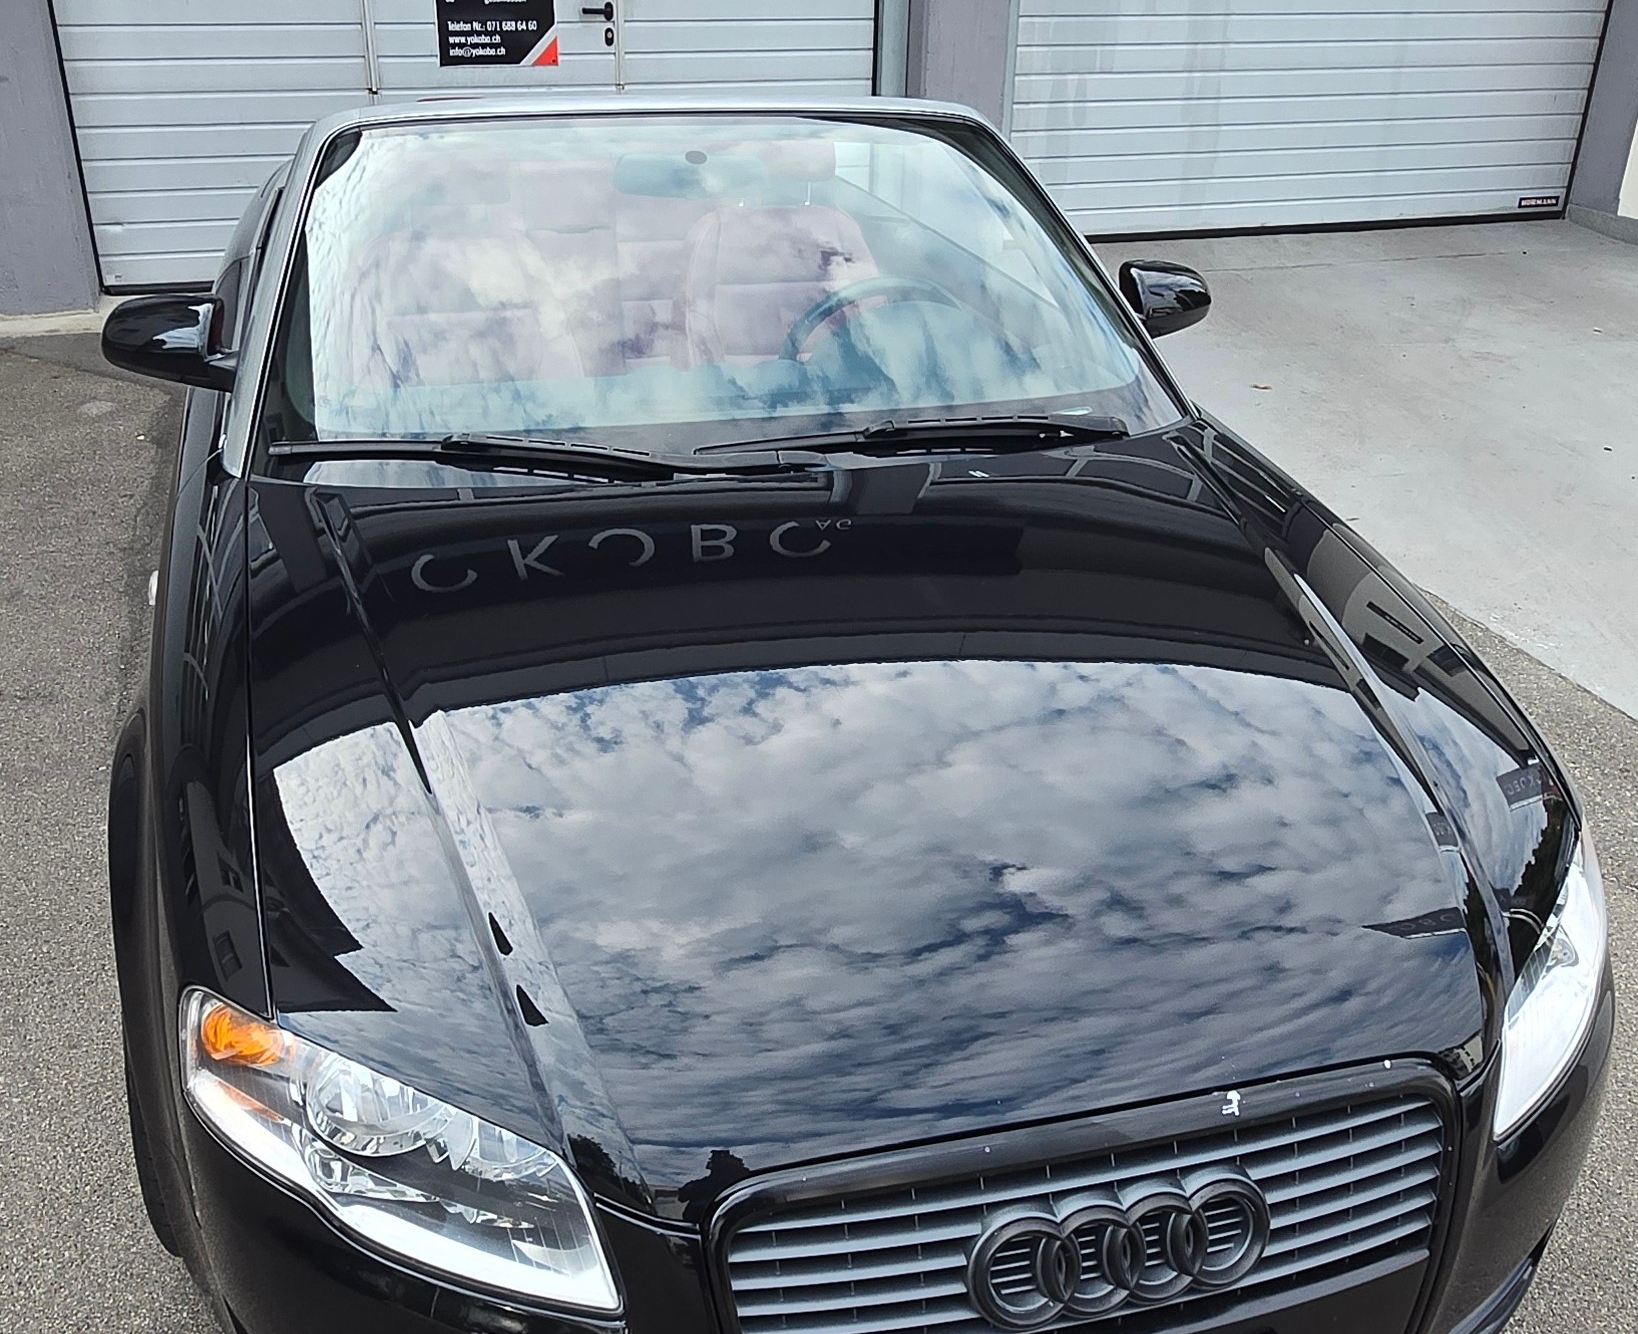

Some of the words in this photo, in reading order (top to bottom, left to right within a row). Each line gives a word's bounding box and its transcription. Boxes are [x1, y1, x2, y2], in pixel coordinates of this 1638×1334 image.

[447, 21, 472, 31] Telefon
[486, 21, 501, 31] 071
[517, 20, 527, 31] 64
[448, 34, 501, 45] www.yokobo.ch
[449, 46, 506, 57] info@yokobo.ch
